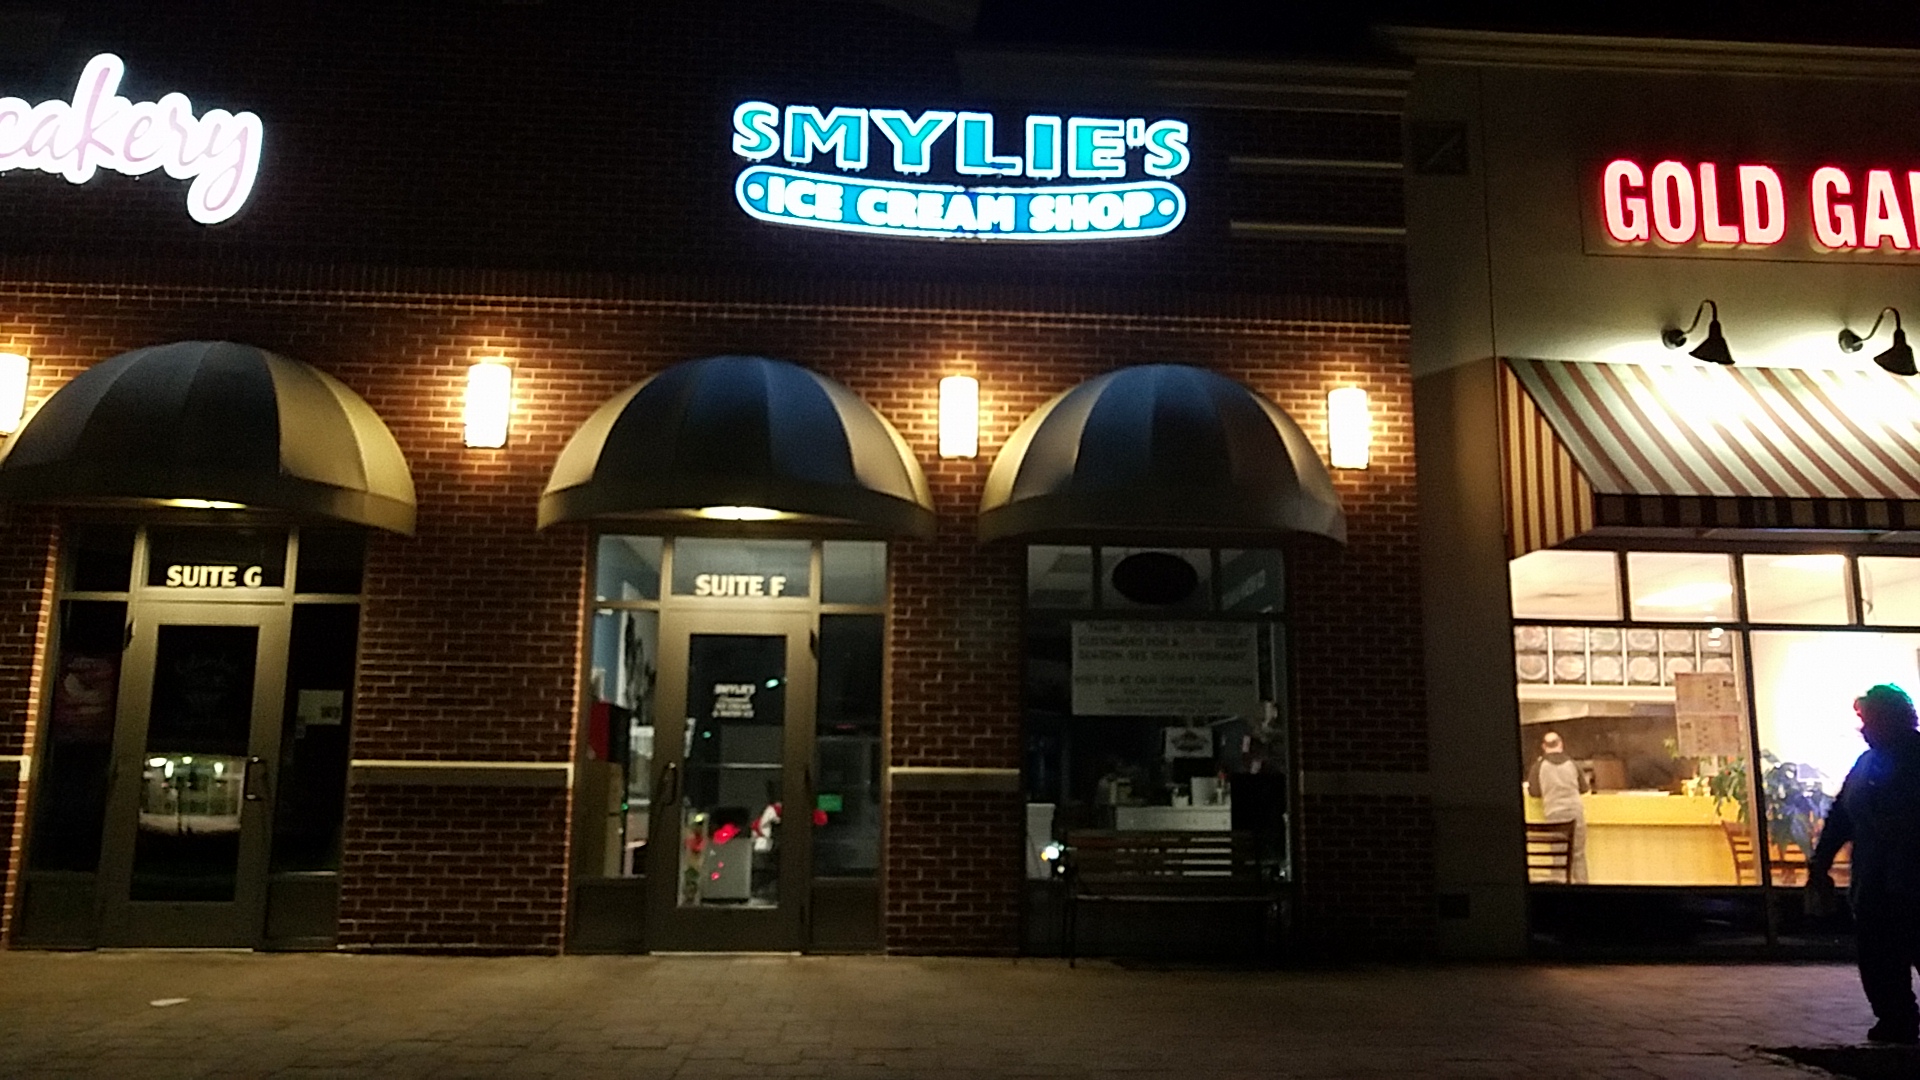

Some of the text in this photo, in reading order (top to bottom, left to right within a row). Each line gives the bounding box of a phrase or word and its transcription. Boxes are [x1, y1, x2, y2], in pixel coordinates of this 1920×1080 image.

[733, 101, 1190, 178] SMYLIE'S
[767, 175, 1155, 232] ICE CREAM SHOP
[1604, 159, 1920, 249] GOLD GA
[166, 565, 262, 588] SUITE G
[695, 574, 787, 597] SUITE F
